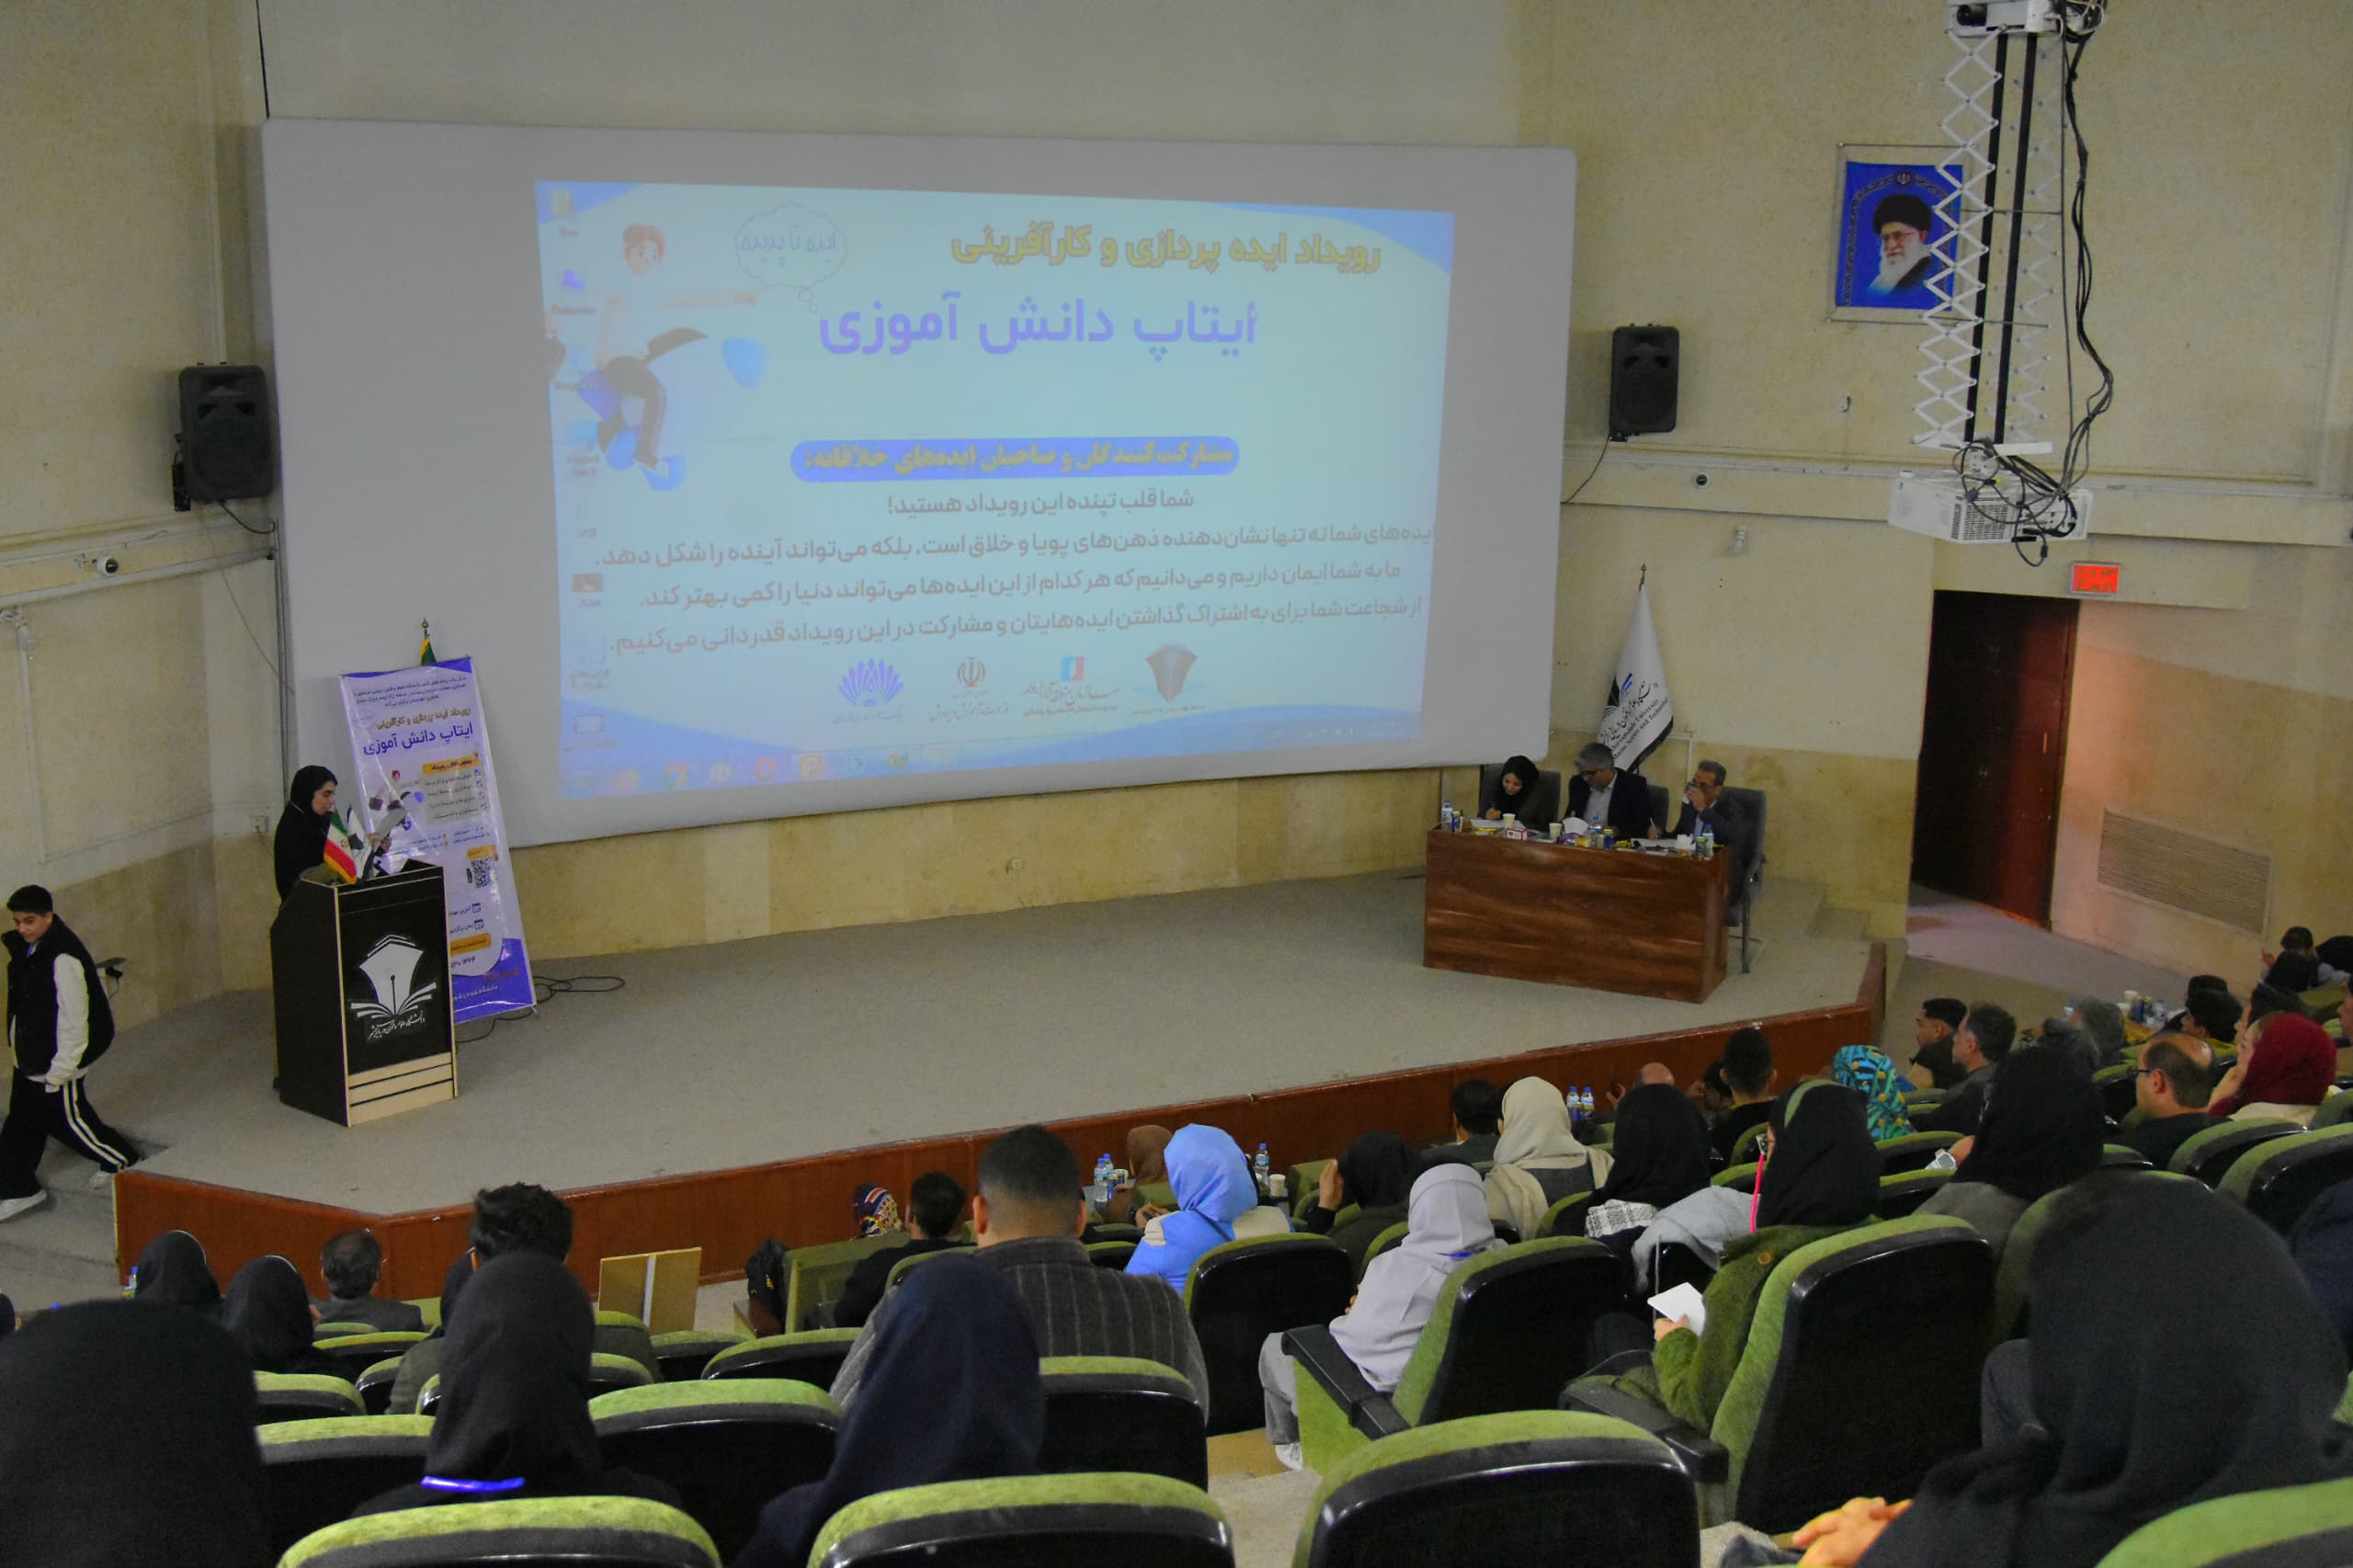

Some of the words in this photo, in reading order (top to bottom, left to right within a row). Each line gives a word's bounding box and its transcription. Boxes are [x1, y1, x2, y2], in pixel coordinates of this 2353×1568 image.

[951, 221, 1092, 267] کارآفرینی
[1100, 236, 1119, 267] و
[1126, 228, 1221, 274] پردازی
[1229, 232, 1287, 271] ایده
[1295, 233, 1381, 274] رویداد
[820, 290, 961, 356] آموزی
[979, 295, 1115, 356] دانش
[887, 494, 962, 524] هستید!
[965, 494, 1027, 522] رویداد
[1031, 492, 1063, 517] این
[1066, 493, 1117, 524] تپنده
[1120, 487, 1155, 514] قلب
[1160, 488, 1194, 509] شما
[969, 533, 1015, 559] خلاق
[1030, 532, 1069, 560] پویا
[1272, 524, 1306, 549] تنها
[1308, 528, 1328, 545] نه
[1330, 525, 1362, 546] شما
[1364, 524, 1433, 546] یده‌های
[596, 549, 652, 566] دهد.
[654, 540, 705, 569] شکل
[707, 542, 724, 569] را
[727, 538, 781, 565] آینده
[871, 535, 913, 562] بلکه
[1017, 540, 1029, 557] و
[1114, 567, 1135, 587] که
[1217, 574, 1225, 590] و
[1230, 564, 1279, 590] داریم
[1281, 562, 1328, 586] ایمان
[1330, 562, 1362, 581] شما
[1365, 565, 1383, 583] به
[1384, 560, 1402, 579] ما
[732, 582, 775, 608] کمی
[779, 583, 792, 607] را
[794, 581, 833, 606] دنیا
[988, 574, 1020, 599] این
[1023, 574, 1037, 596] از
[1040, 570, 1084, 596] کدام
[1083, 572, 1110, 595] هر
[640, 585, 680, 608] کند.
[681, 588, 728, 612] بهتر
[1312, 600, 1342, 618] شما
[1345, 597, 1407, 621] شجاعت
[1409, 595, 1422, 618] از
[1116, 603, 1184, 632] گذاشتن
[1187, 603, 1249, 627] اشتراک
[1250, 606, 1269, 626] به
[1271, 600, 1309, 624] برای
[701, 620, 785, 651] قدردانی
[789, 622, 853, 645] رویداد
[858, 619, 891, 644] این
[893, 615, 915, 642] در
[918, 614, 994, 641] مشارکت
[997, 620, 1006, 637] و
[363, 733, 399, 756] آموزی
[402, 730, 437, 750] دانش
[439, 722, 473, 744] ایتاپ
